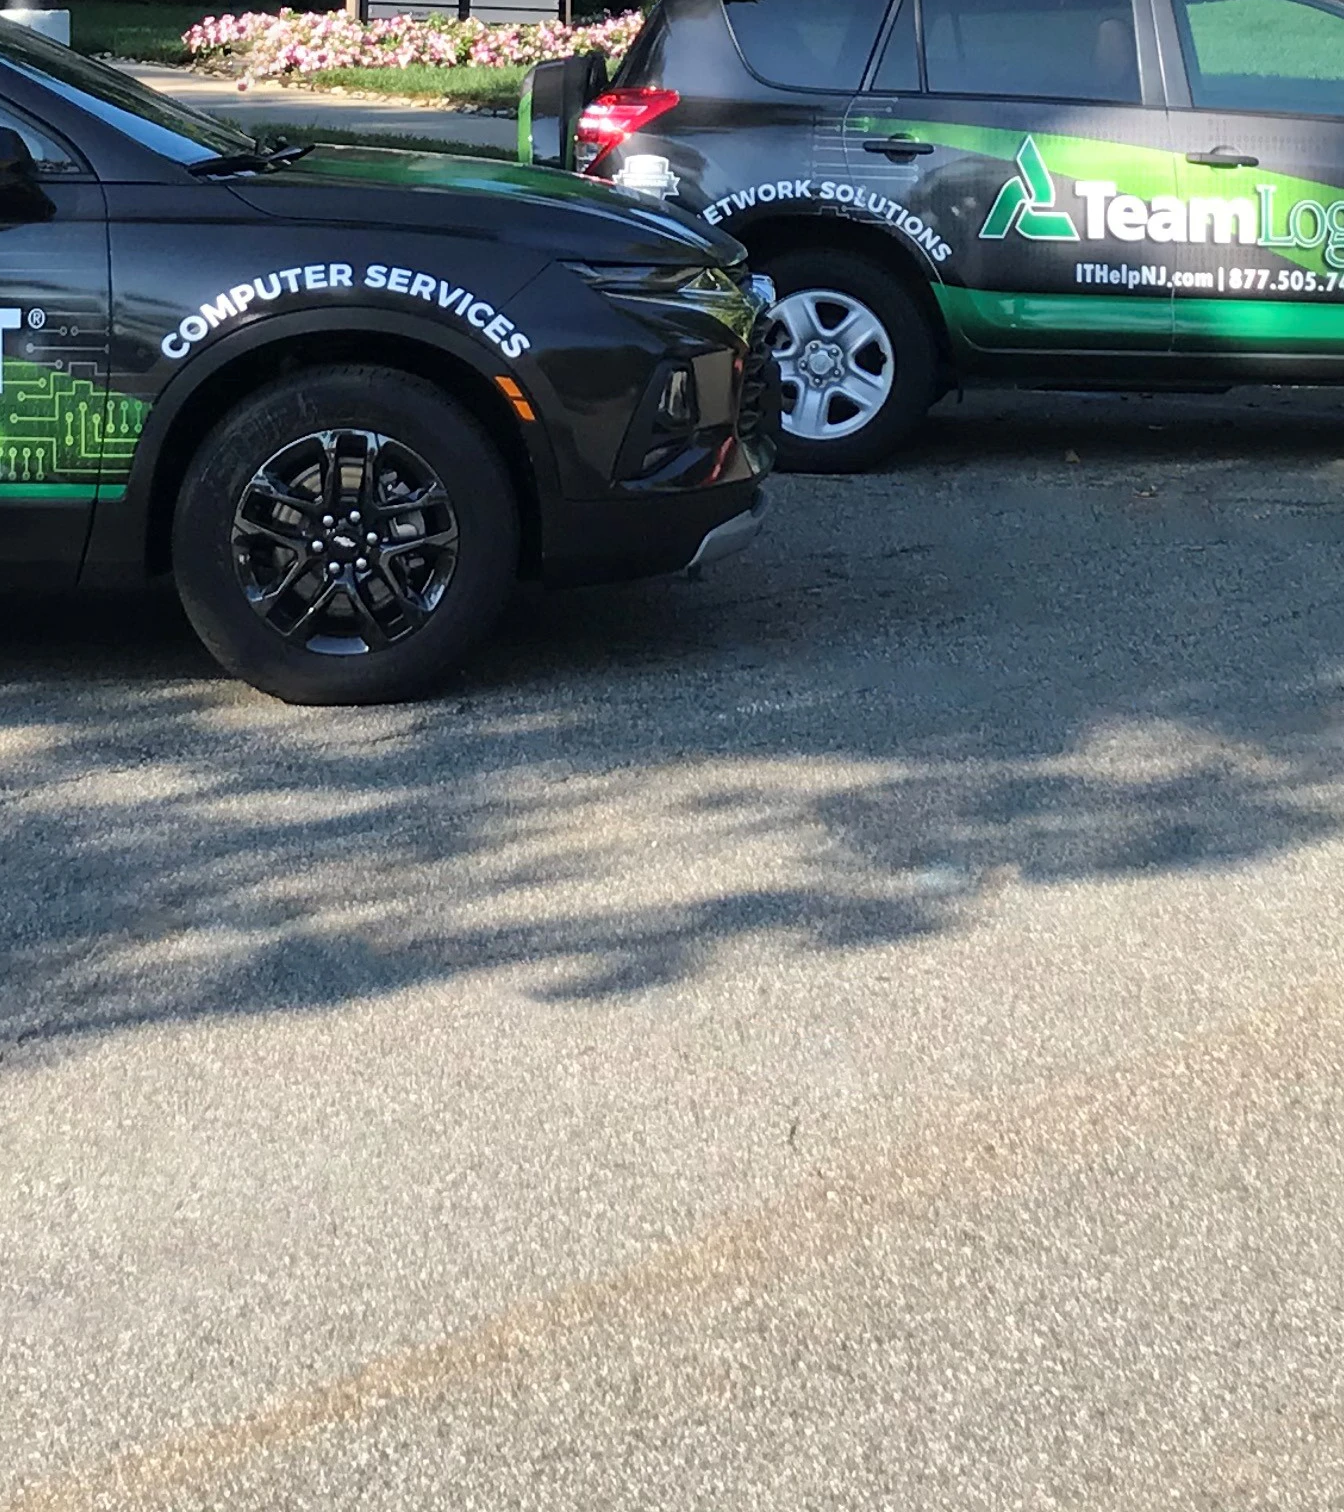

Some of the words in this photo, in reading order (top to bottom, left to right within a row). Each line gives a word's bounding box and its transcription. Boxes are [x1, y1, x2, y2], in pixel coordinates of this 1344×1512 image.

[696, 179, 812, 227] ETWORK
[819, 181, 953, 262] SOLUTIONS
[160, 262, 354, 360] COMPUTER
[364, 263, 531, 360] SERVICES
[1076, 263, 1214, 289] ITHelpNJ.com
